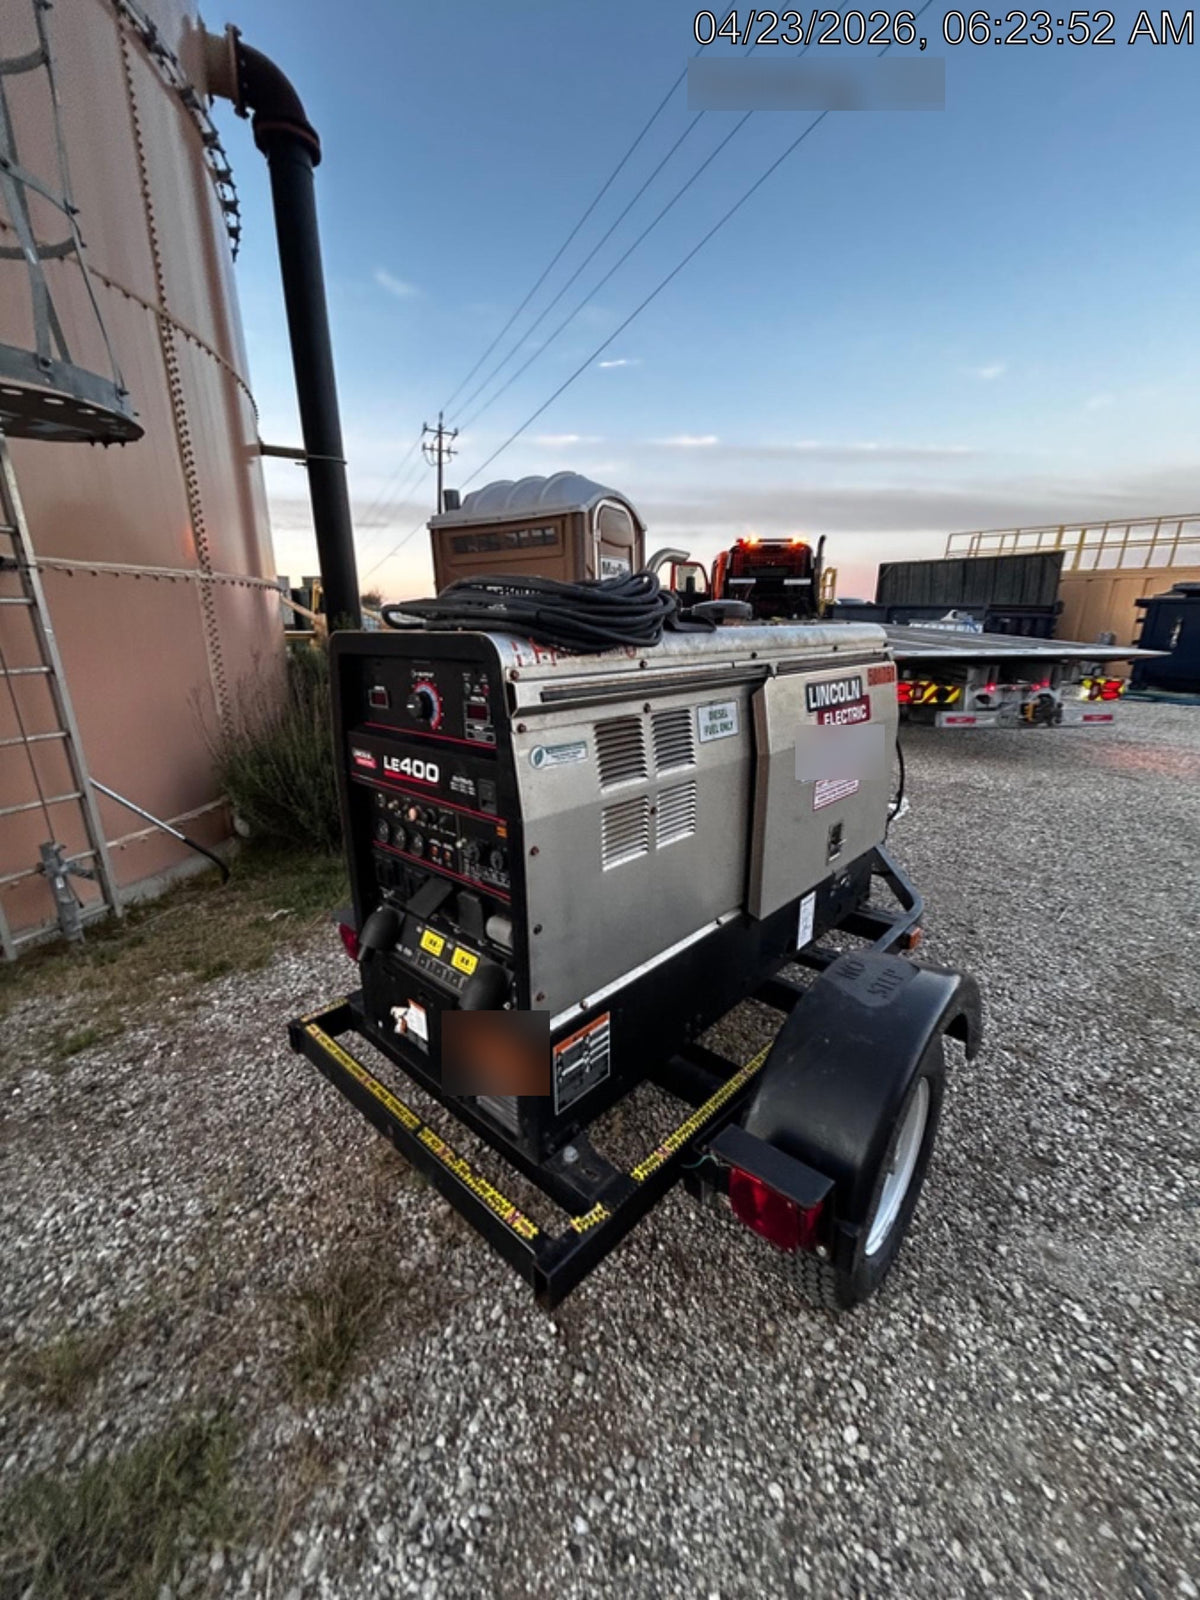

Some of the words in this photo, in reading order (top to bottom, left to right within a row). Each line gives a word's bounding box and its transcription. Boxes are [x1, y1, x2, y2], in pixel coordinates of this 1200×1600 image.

[808, 679, 860, 709] LINCOLN
[823, 703, 867, 725] ELECTRIC
[383, 755, 440, 783] LE400
[836, 961, 865, 980] NO
